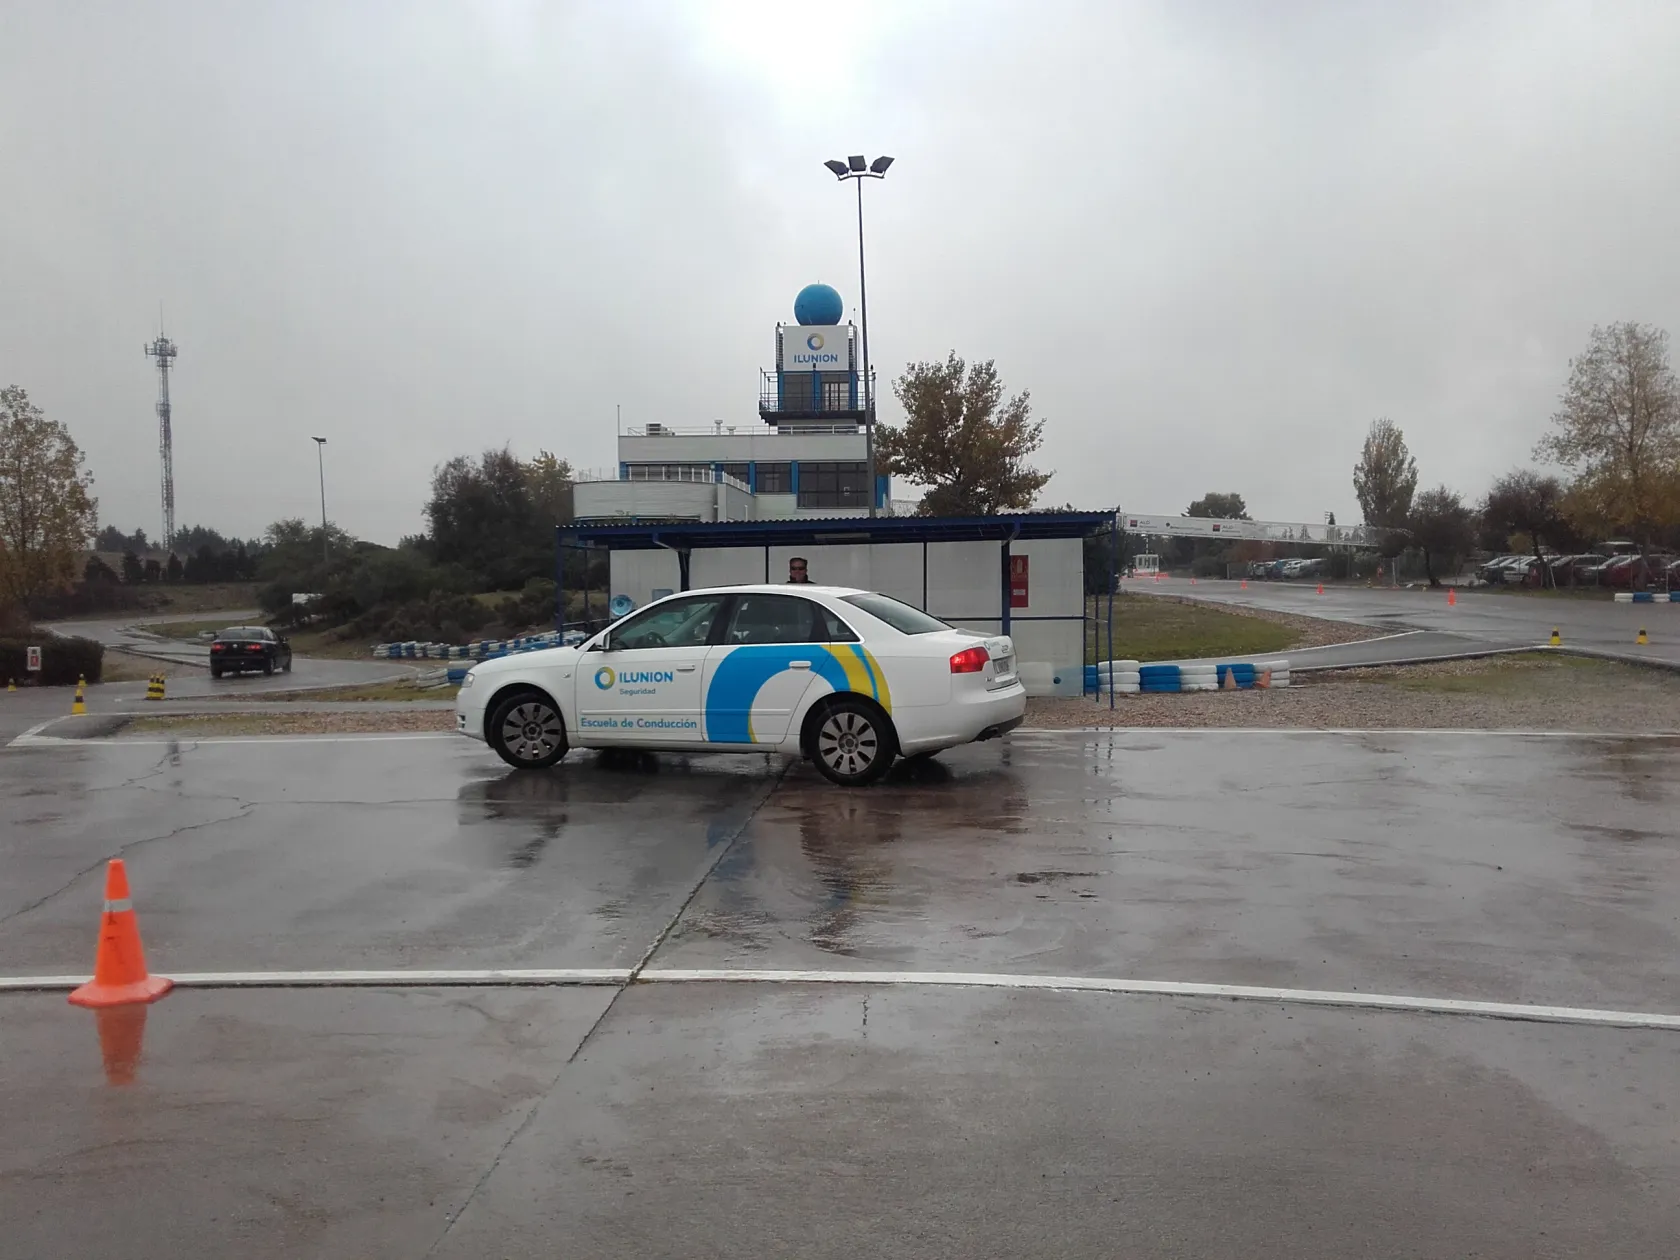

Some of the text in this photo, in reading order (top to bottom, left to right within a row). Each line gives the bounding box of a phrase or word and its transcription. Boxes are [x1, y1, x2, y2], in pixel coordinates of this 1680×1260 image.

[794, 354, 838, 363] ILUNION
[619, 671, 674, 683] ILUNION
[620, 688, 656, 696] Seguridad
[581, 717, 697, 729] Escuela de Conducción
